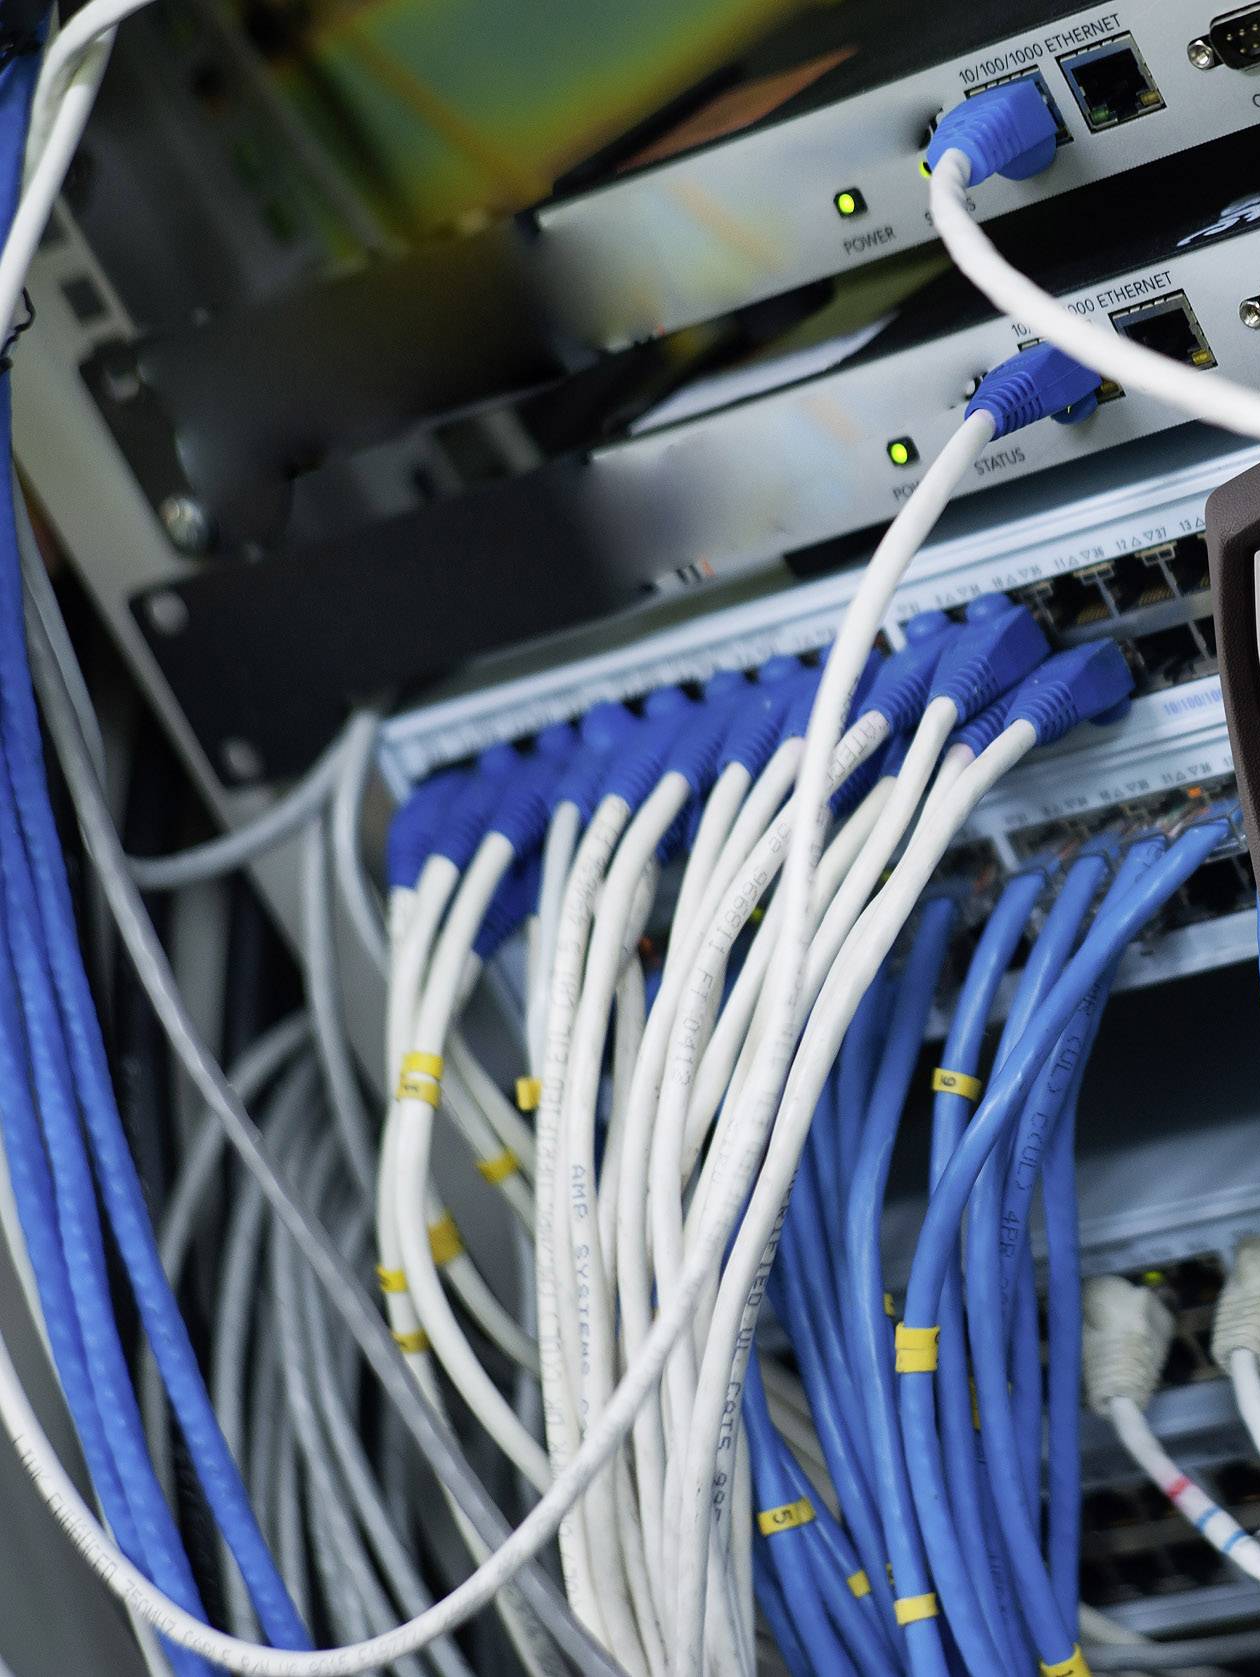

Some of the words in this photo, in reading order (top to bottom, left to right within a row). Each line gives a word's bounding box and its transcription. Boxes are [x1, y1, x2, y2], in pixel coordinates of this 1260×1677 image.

[959, 43, 1043, 85] 10/100/1000
[1045, 13, 1122, 54] ETHERNET
[843, 226, 897, 256] POWER
[1096, 271, 1173, 309] ETHERNET
[974, 447, 1026, 476] STATUS
[1179, 519, 1192, 532] 13
[571, 1163, 588, 1219] AMP
[772, 1508, 793, 1524] 5
